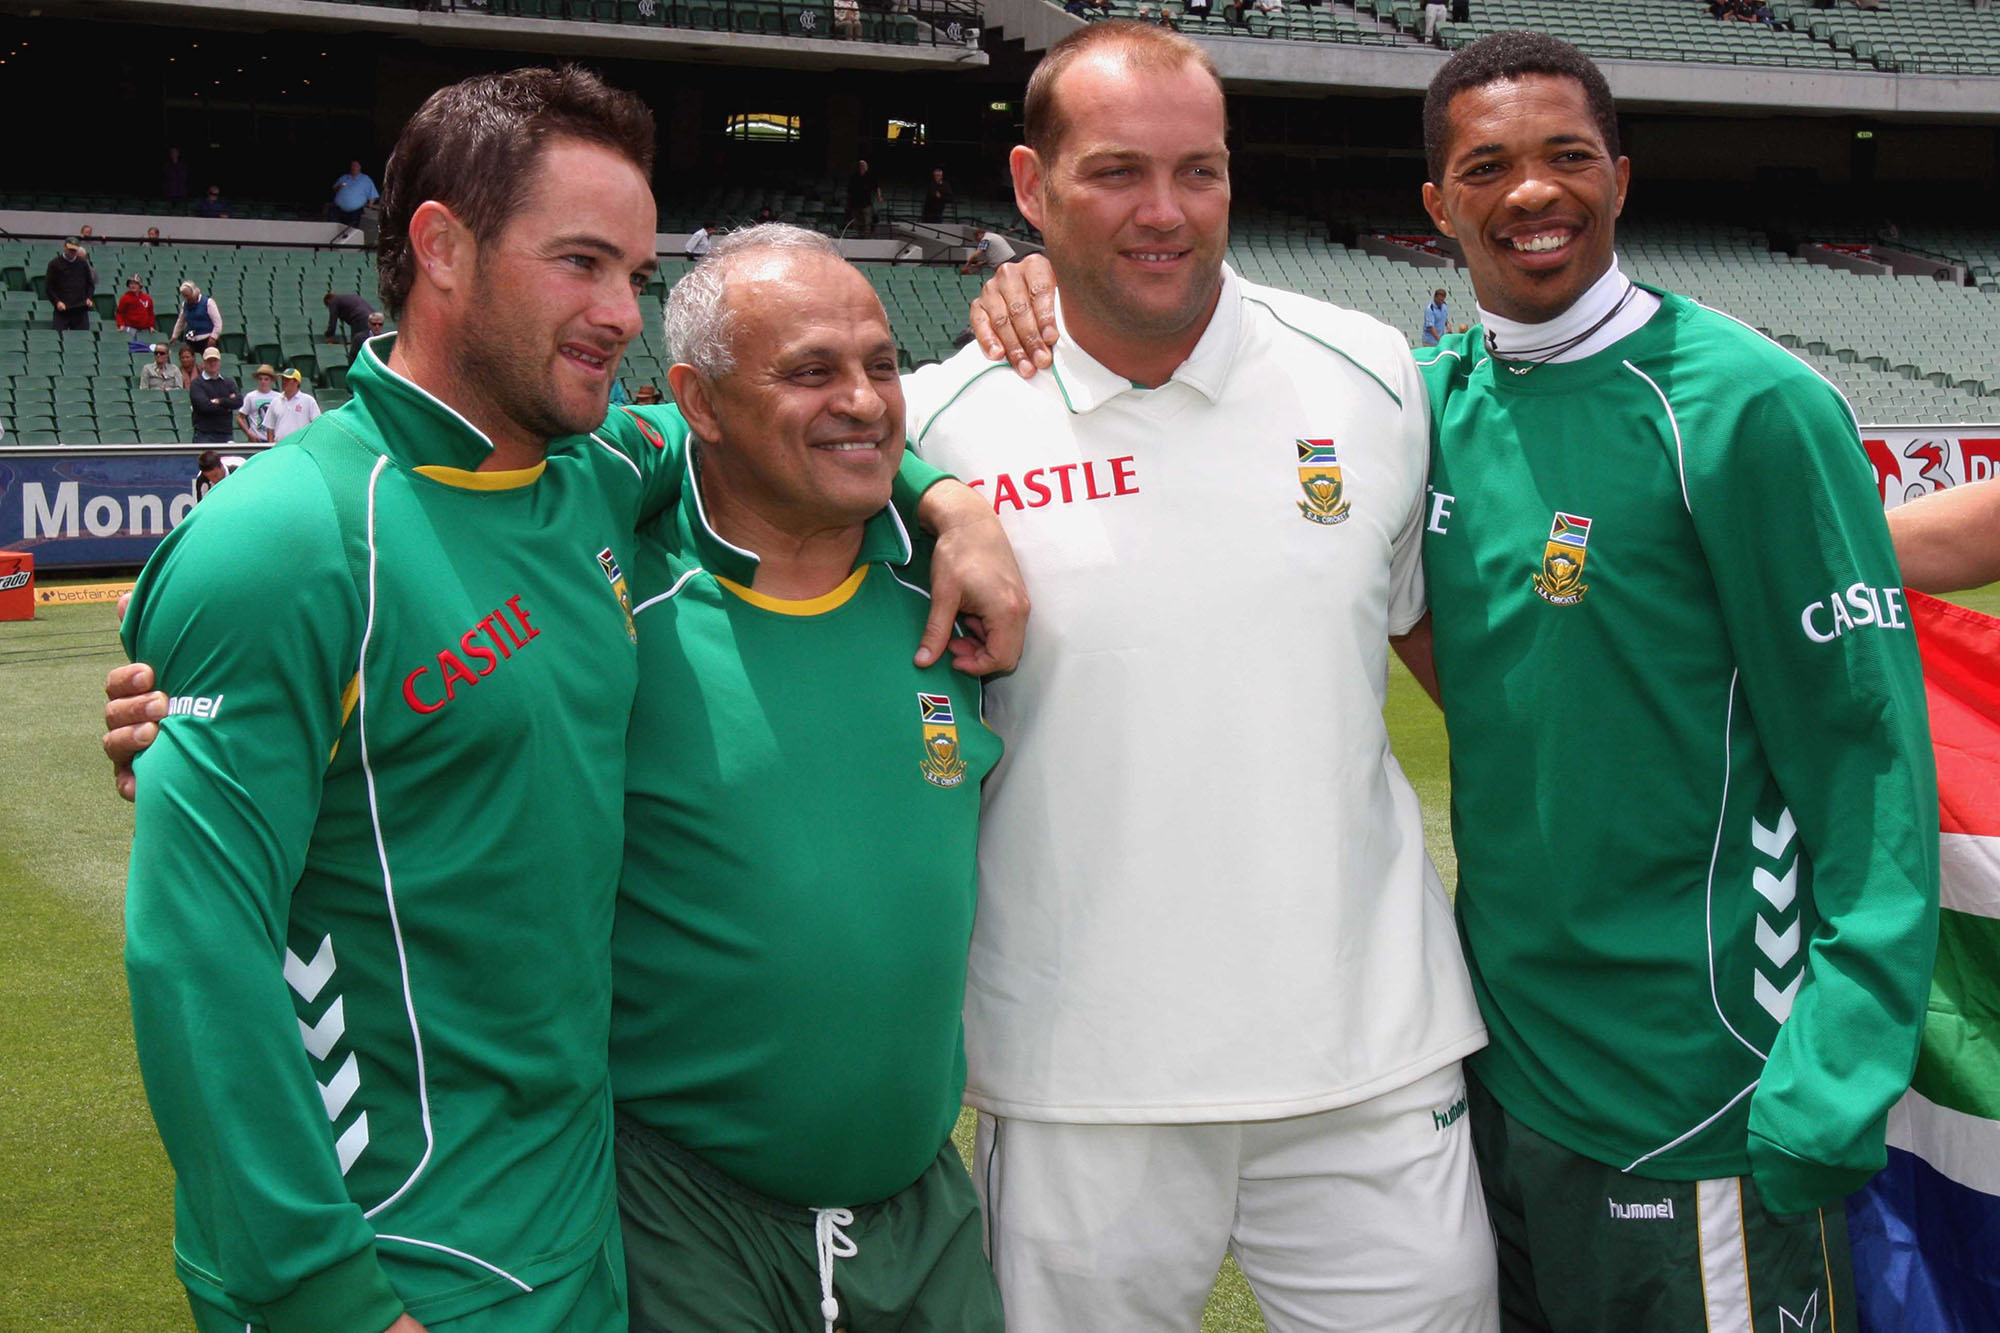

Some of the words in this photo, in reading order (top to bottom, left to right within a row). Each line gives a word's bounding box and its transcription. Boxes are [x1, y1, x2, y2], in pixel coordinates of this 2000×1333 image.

[967, 455, 1140, 516] ASTLE
[1801, 582, 1906, 643] CASLE
[402, 594, 541, 715] CASTLE
[1608, 1197, 1674, 1220] hummel
